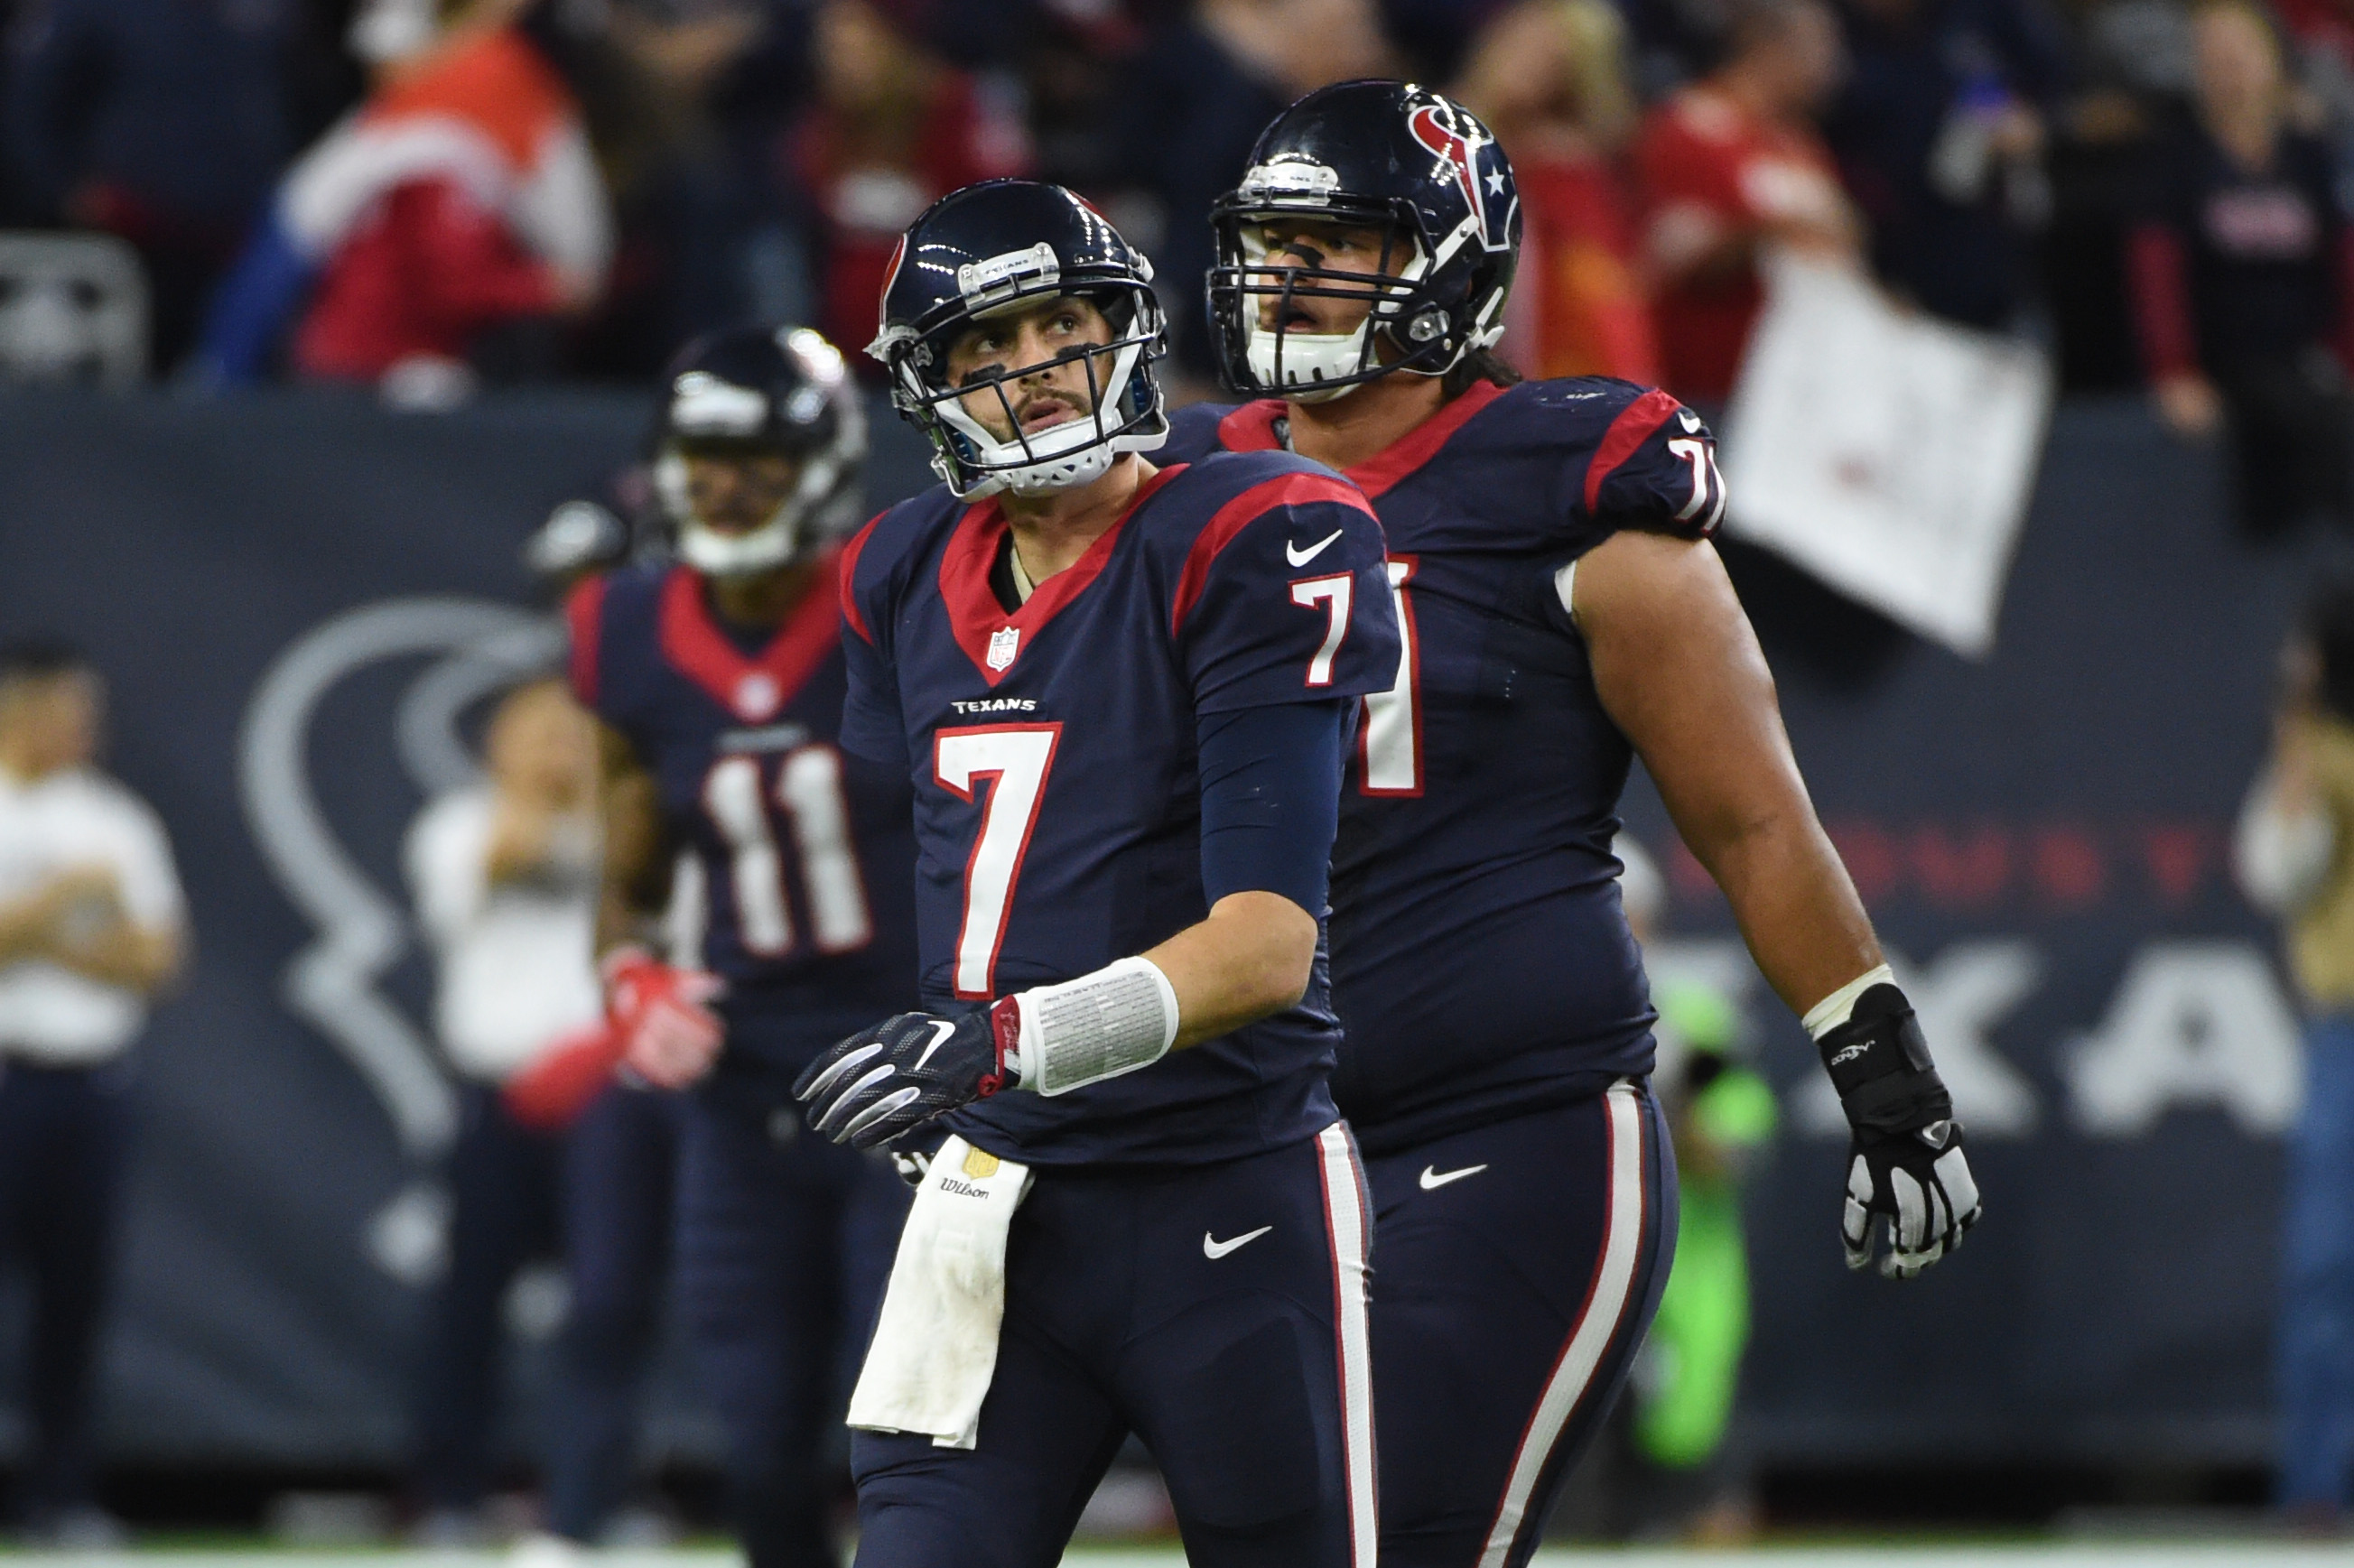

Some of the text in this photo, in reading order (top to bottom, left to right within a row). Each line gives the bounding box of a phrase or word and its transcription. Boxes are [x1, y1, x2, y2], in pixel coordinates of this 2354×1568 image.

[1668, 436, 1726, 536] 71
[1287, 569, 1354, 687] 7
[951, 698, 1037, 714] TEXANS
[700, 746, 874, 956] 11
[933, 721, 1064, 1000] 7
[941, 1177, 990, 1199] Wilson
